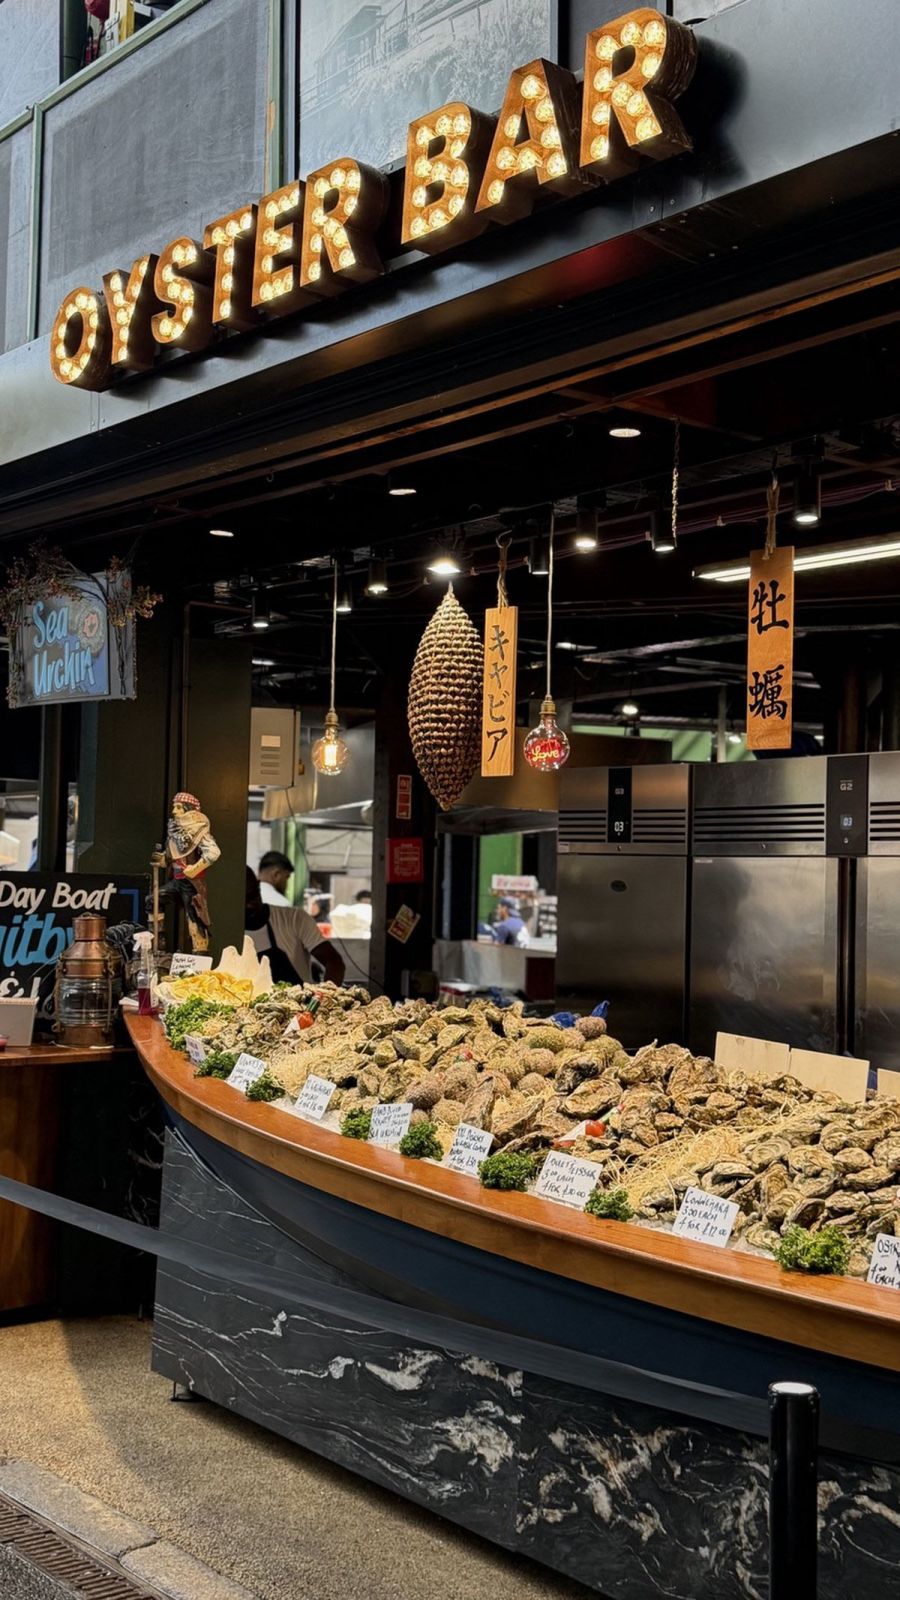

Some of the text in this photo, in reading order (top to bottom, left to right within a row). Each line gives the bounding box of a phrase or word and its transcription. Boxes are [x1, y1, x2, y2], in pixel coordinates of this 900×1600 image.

[50, 7, 692, 388] OYSTER BAR
[33, 600, 69, 648] Sea
[749, 580, 789, 720] 牡蠣
[33, 641, 95, 698] Urchin
[487, 624, 509, 762] キャビア
[531, 745, 560, 762] Love
[614, 821, 624, 832] 03
[0, 880, 117, 915] Day Boat
